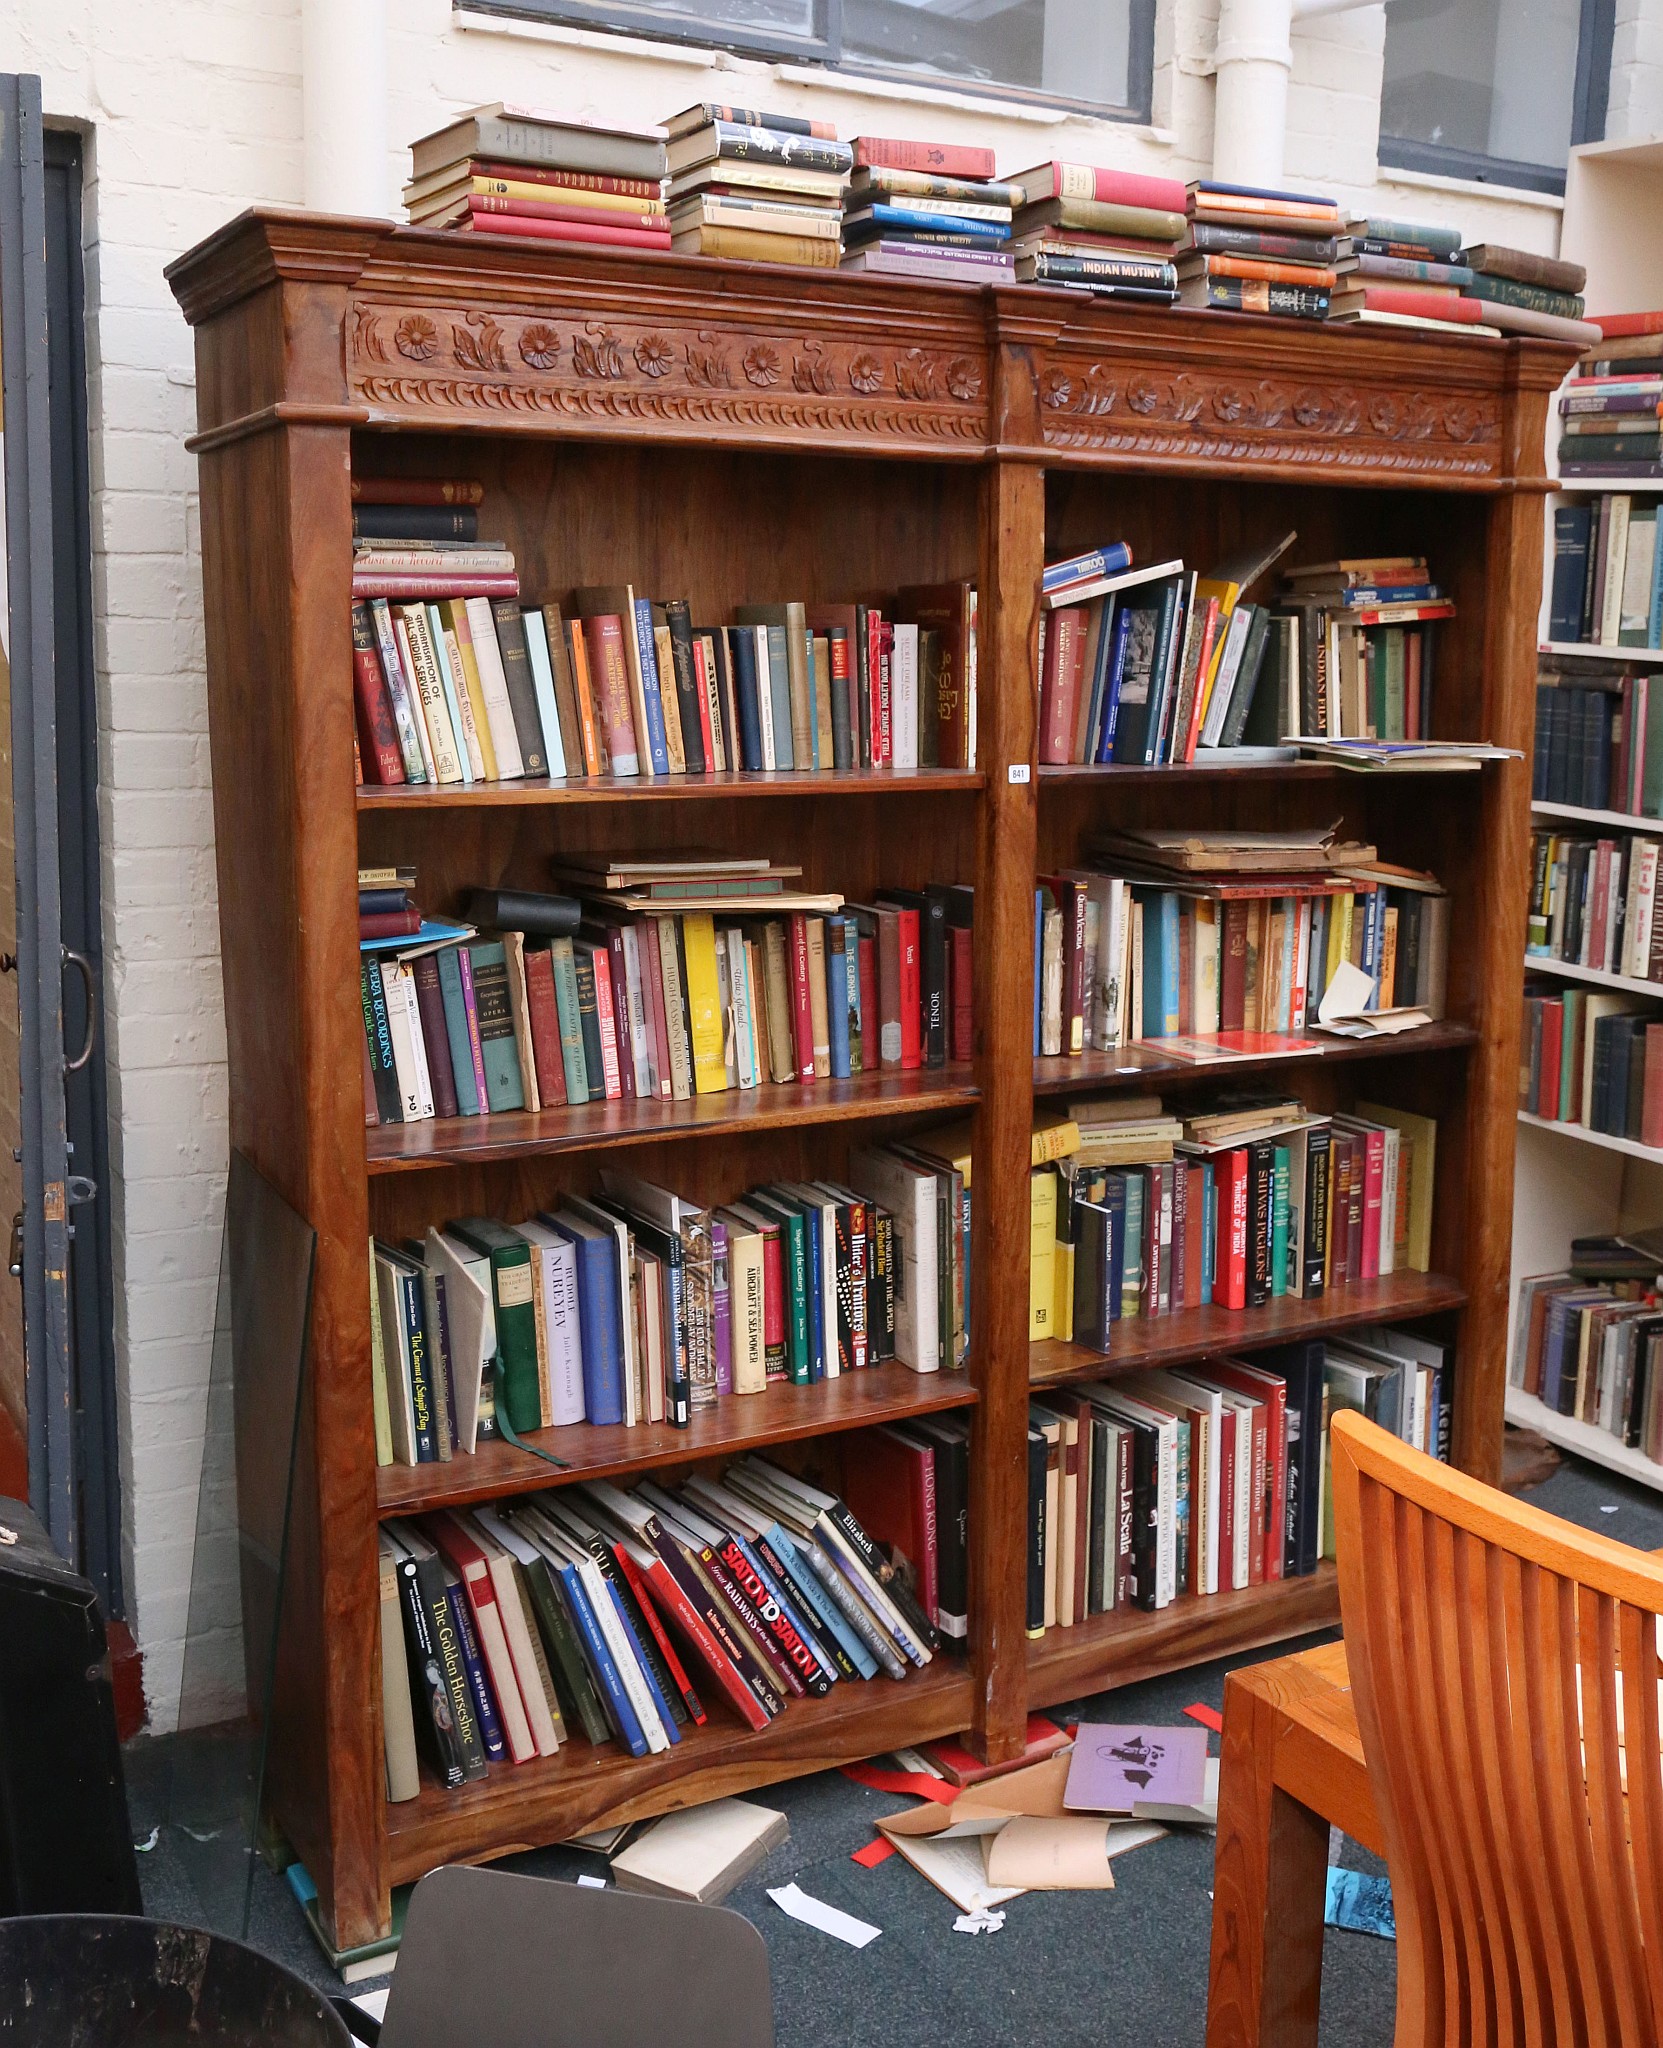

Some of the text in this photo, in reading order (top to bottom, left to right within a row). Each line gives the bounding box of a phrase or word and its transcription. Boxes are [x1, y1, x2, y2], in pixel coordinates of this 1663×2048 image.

[556, 171, 603, 191] ANNUAL
[613, 178, 649, 195] OPERA
[1083, 261, 1120, 276] INDIAN
[1122, 265, 1161, 279] MUTINY
[637, 610, 644, 619] TO
[645, 625, 654, 658] JAPANESE
[415, 664, 432, 706] SERVICES
[648, 660, 658, 691] MISSION
[708, 661, 718, 707] JAPAN
[1317, 644, 1326, 730] INDIAN FILM
[432, 687, 441, 699] OF
[1012, 768, 1025, 778] 841
[1076, 894, 1086, 950] QUEEN VICTORIA
[906, 945, 914, 964] Verdi
[846, 948, 857, 1002] THE GURKHAS
[483, 1008, 506, 1017] OPERA
[598, 977, 607, 1017] GEOFFREY
[603, 981, 611, 1011] MARCUS
[931, 992, 940, 1029] TENOR
[368, 958, 393, 1068] OPERA RECORDINGS
[666, 966, 684, 1070] HUGH CASSON DIARY
[602, 1017, 621, 1095] THE MAIDEN VOYAGE
[1175, 1168, 1184, 1223] REDGRAVE
[1233, 1181, 1241, 1215] PRINCES
[1234, 1218, 1240, 1230] OF
[1256, 1170, 1268, 1282] SHIVA'S PIGEONS
[550, 1255, 566, 1329] NUREYEV
[565, 1267, 575, 1314] RUDOLF
[747, 1267, 755, 1309] AIRCRAFT
[851, 1234, 866, 1332] Hitler's Traitors
[886, 1274, 893, 1284] AT
[672, 1270, 684, 1379] EDINBURGH BY NIGHT
[687, 1281, 695, 1336] AFTERNOONS
[411, 1331, 421, 1348] The
[749, 1318, 757, 1334] SEA
[413, 1348, 423, 1376] Cinema
[749, 1334, 758, 1364] POWER
[565, 1359, 573, 1399] Kavanagh
[698, 1365, 705, 1380] AT
[417, 1384, 427, 1410] Satyajit
[419, 1412, 429, 1431] Ray
[1252, 1427, 1264, 1512] THE GRAMOPHONE
[925, 1466, 937, 1550] HONG KONG
[1121, 1489, 1133, 1512] La
[841, 1513, 875, 1554] Elizabeth
[1119, 1512, 1133, 1556] Scala
[772, 1534, 792, 1558] Victoria
[791, 1560, 808, 1582] Albert,
[803, 1579, 819, 1597] Vicky
[818, 1599, 829, 1612] The
[825, 1609, 840, 1627] Kaiser
[1118, 1576, 1126, 1601] Praeger
[677, 1601, 697, 1628] Calligraphy
[708, 1612, 723, 1630] livre
[711, 1565, 727, 1586] Great
[723, 1581, 758, 1630] RAILWAYS
[764, 1639, 778, 1655] World
[721, 1542, 818, 1677] STATION TO STATION
[693, 1625, 710, 1647] Japanese
[717, 1626, 728, 1637] du
[722, 1634, 743, 1660] souvenir
[432, 1596, 474, 1744] The Golden Horseshoe
[709, 1650, 718, 1660] Art
[714, 1658, 724, 1669] The
